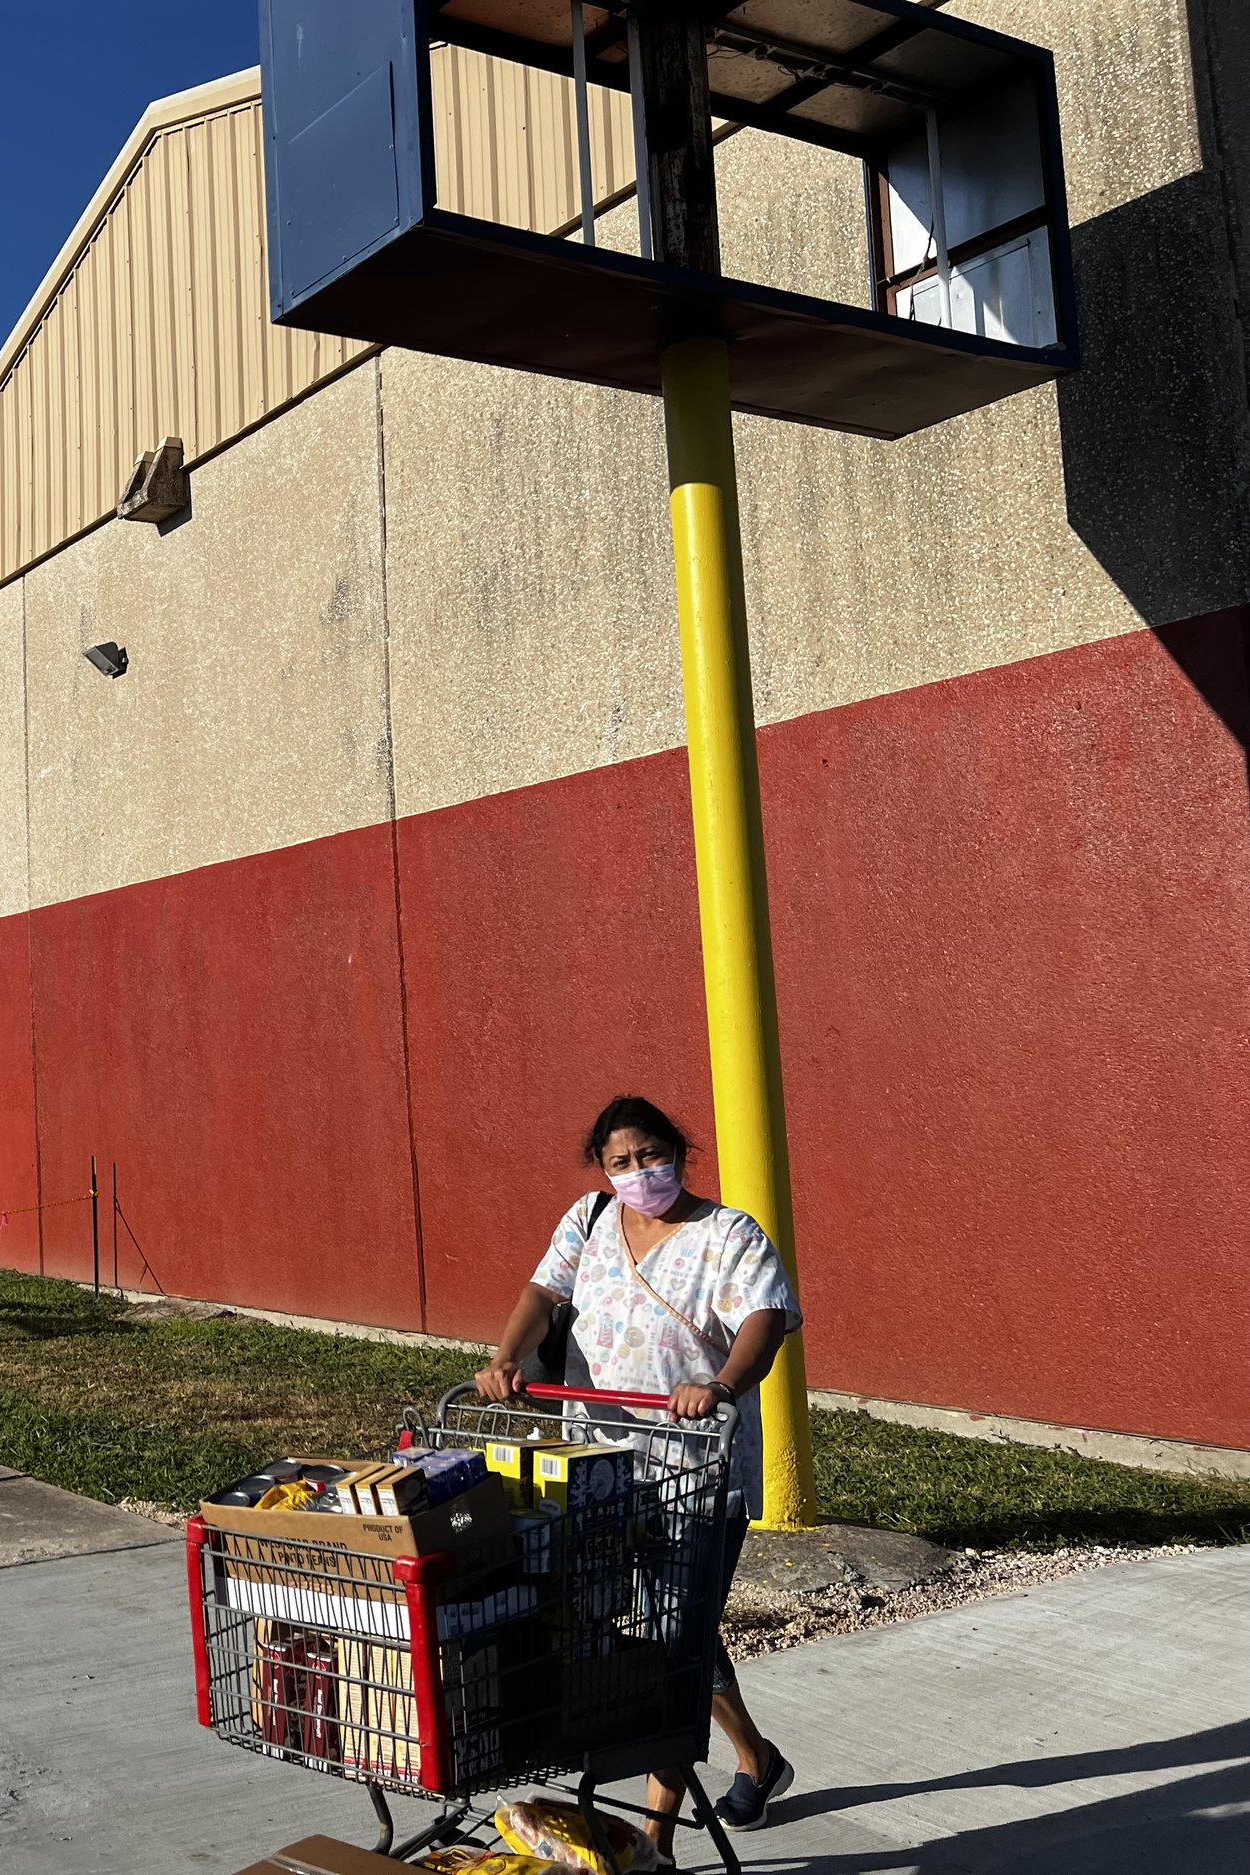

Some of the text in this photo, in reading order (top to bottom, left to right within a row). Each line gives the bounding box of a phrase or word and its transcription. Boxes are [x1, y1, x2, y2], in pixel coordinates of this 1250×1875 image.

[362, 1524, 403, 1534] PRODUCT OF
[378, 1533, 392, 1542] USA
